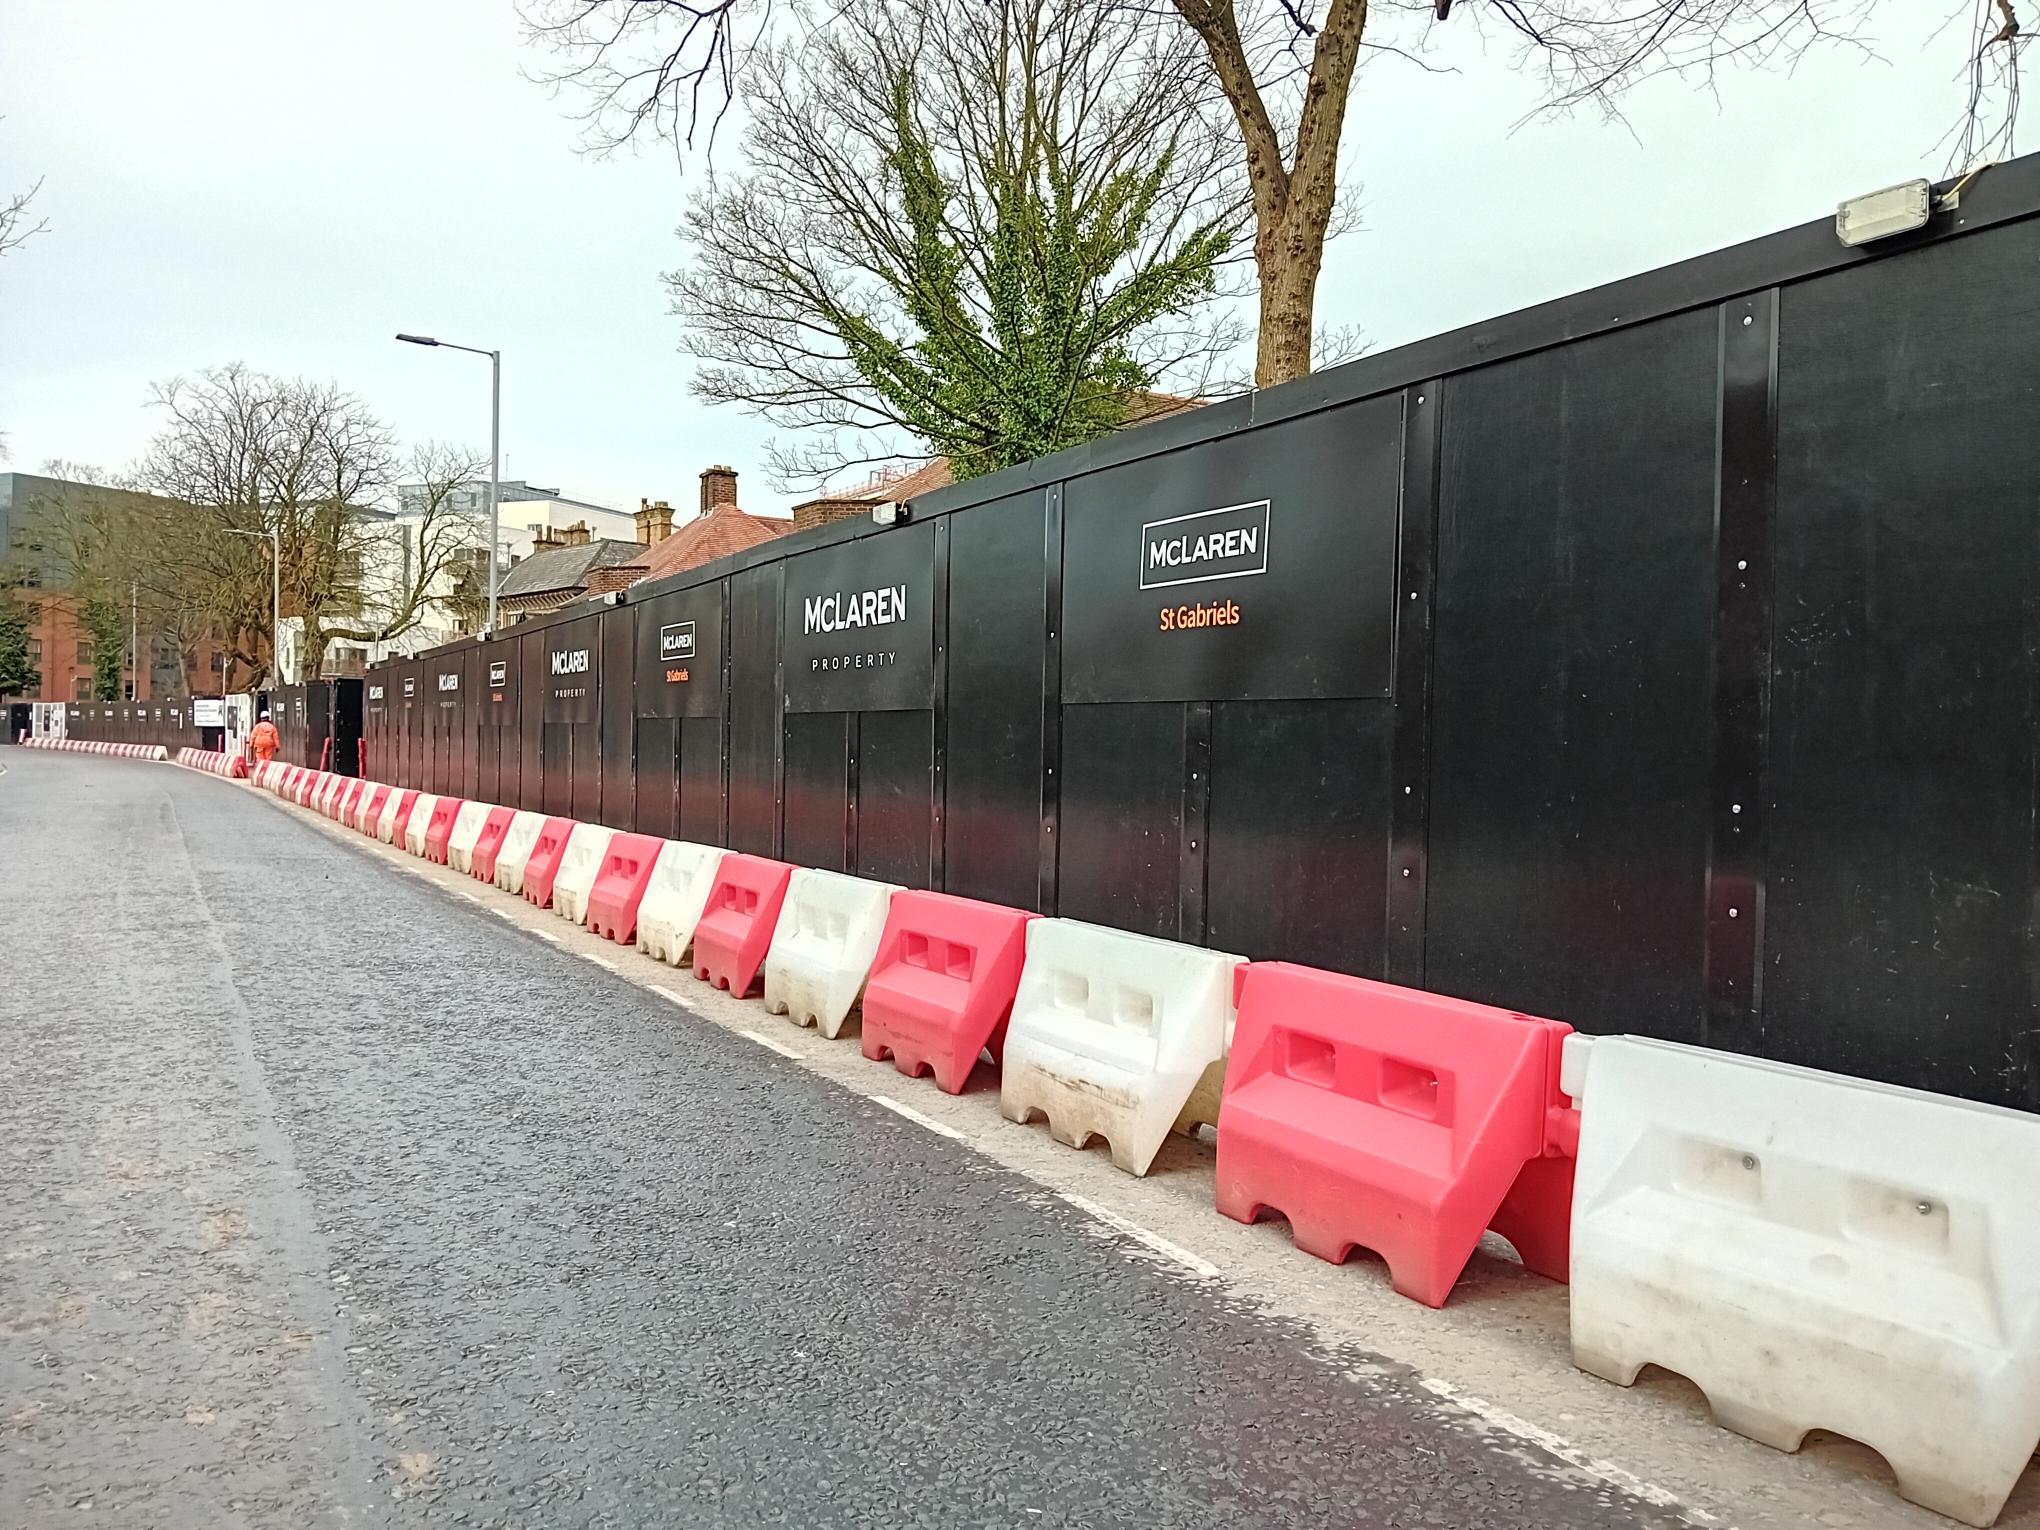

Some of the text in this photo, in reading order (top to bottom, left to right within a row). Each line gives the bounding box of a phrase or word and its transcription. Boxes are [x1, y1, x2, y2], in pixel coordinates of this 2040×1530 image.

[1160, 599, 1240, 631] St Gabriels
[812, 651, 896, 671] PROPERTY
[555, 687, 586, 698] PROPERTY
